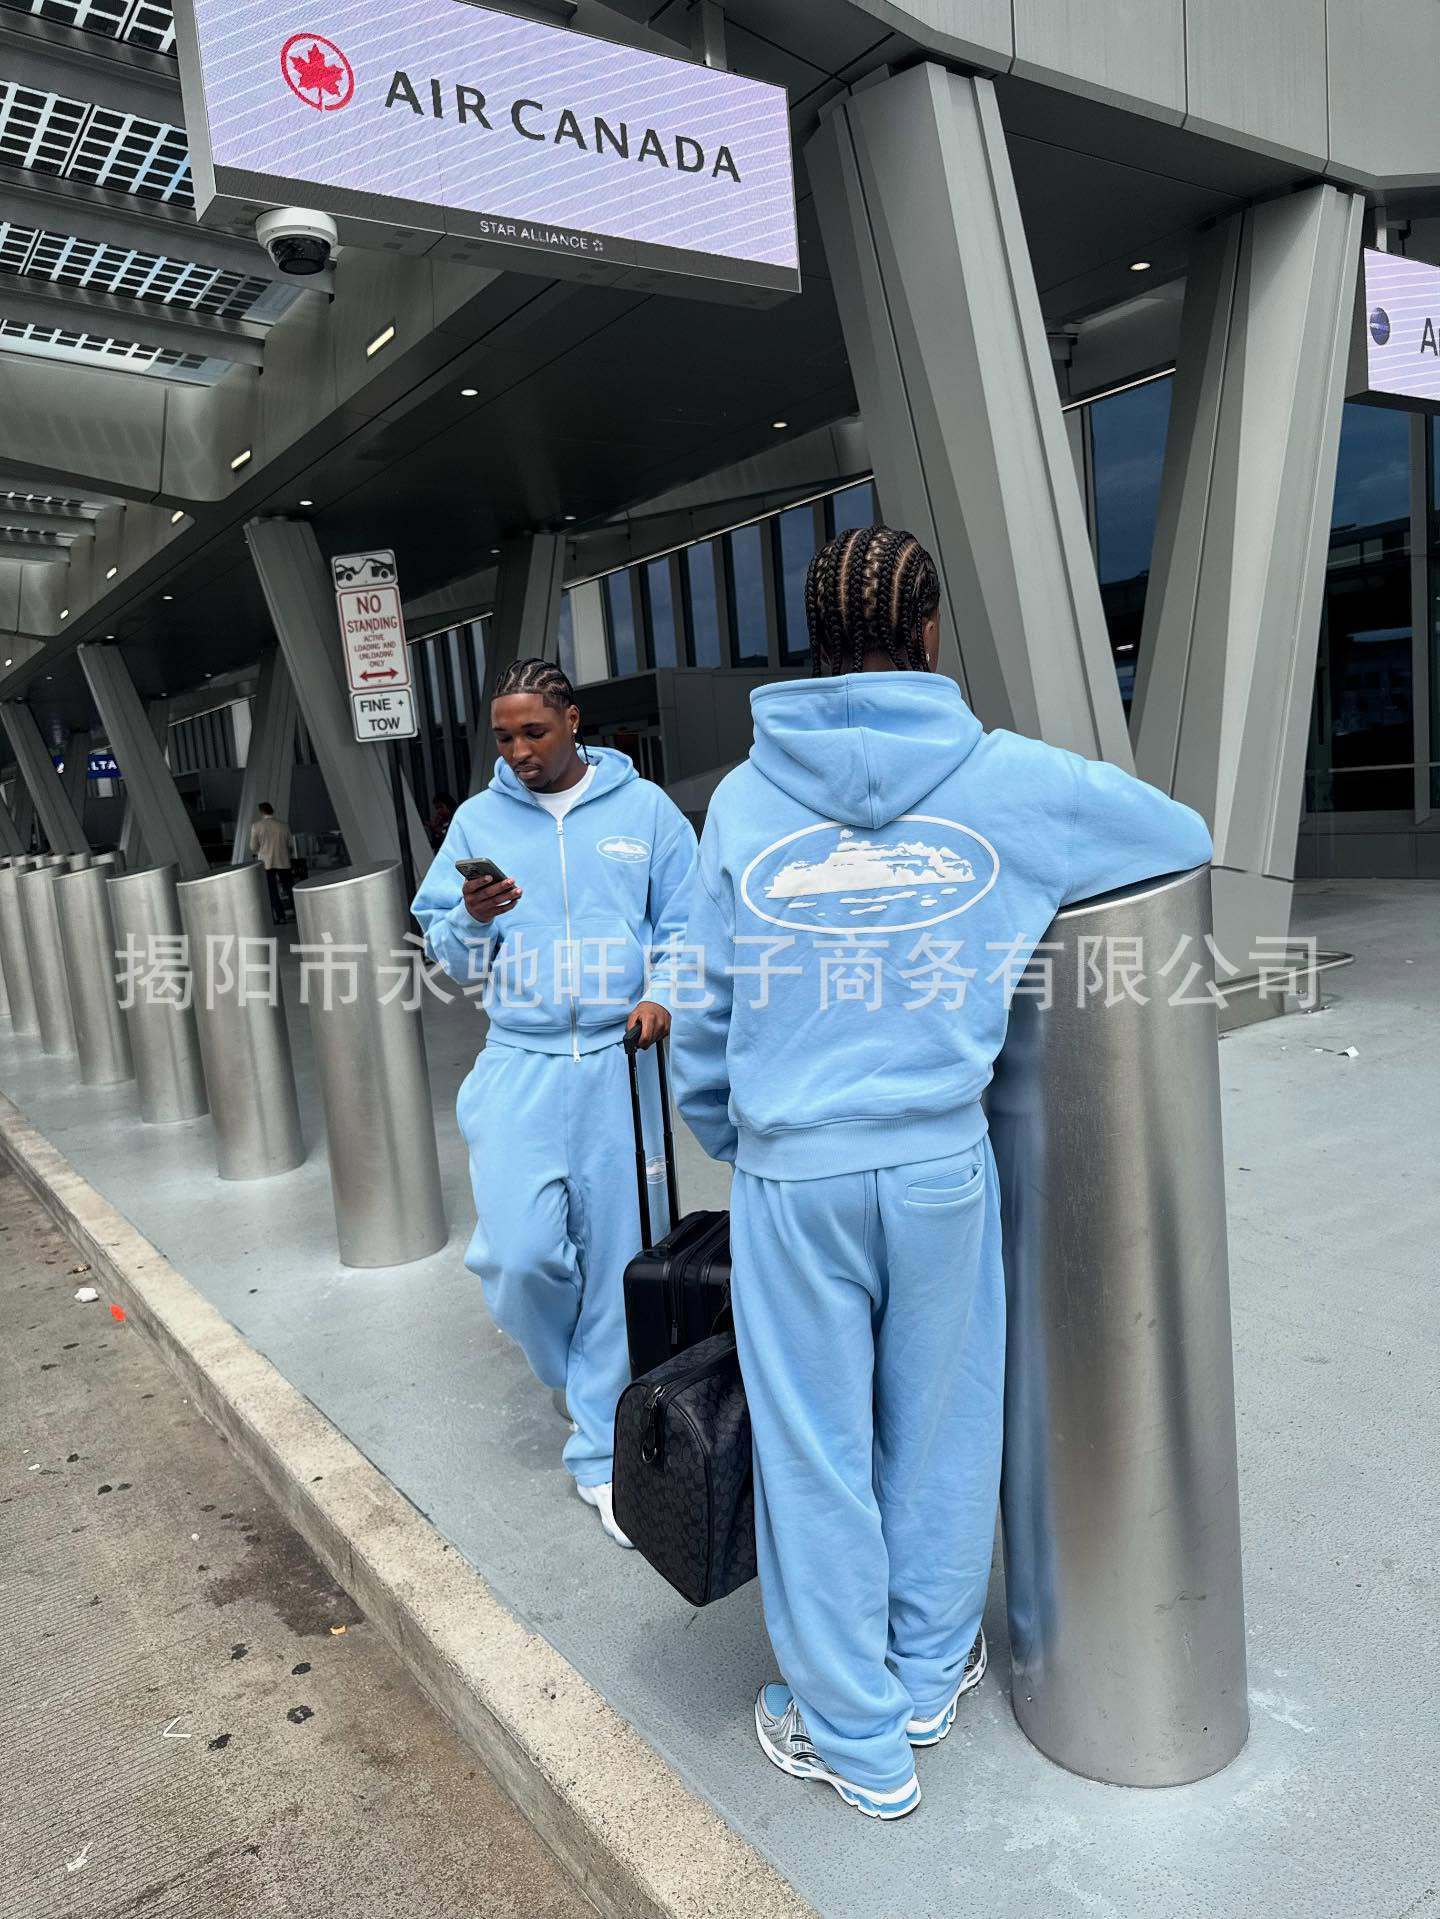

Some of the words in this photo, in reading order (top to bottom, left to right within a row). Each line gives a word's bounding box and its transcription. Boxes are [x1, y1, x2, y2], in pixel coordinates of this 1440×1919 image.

[386, 70, 493, 130] AIR
[510, 99, 741, 184] CANADA
[480, 220, 517, 237] STAR
[521, 227, 589, 251] ALLIANCE
[1420, 317, 1440, 358] A
[356, 595, 382, 615] NO
[347, 616, 398, 633] STANDING
[354, 642, 381, 652] LOADING
[383, 641, 397, 649] AND
[369, 660, 385, 668] ONLY
[360, 698, 392, 713] FINE
[368, 716, 401, 731] TOW
[87, 760, 118, 771] LTA
